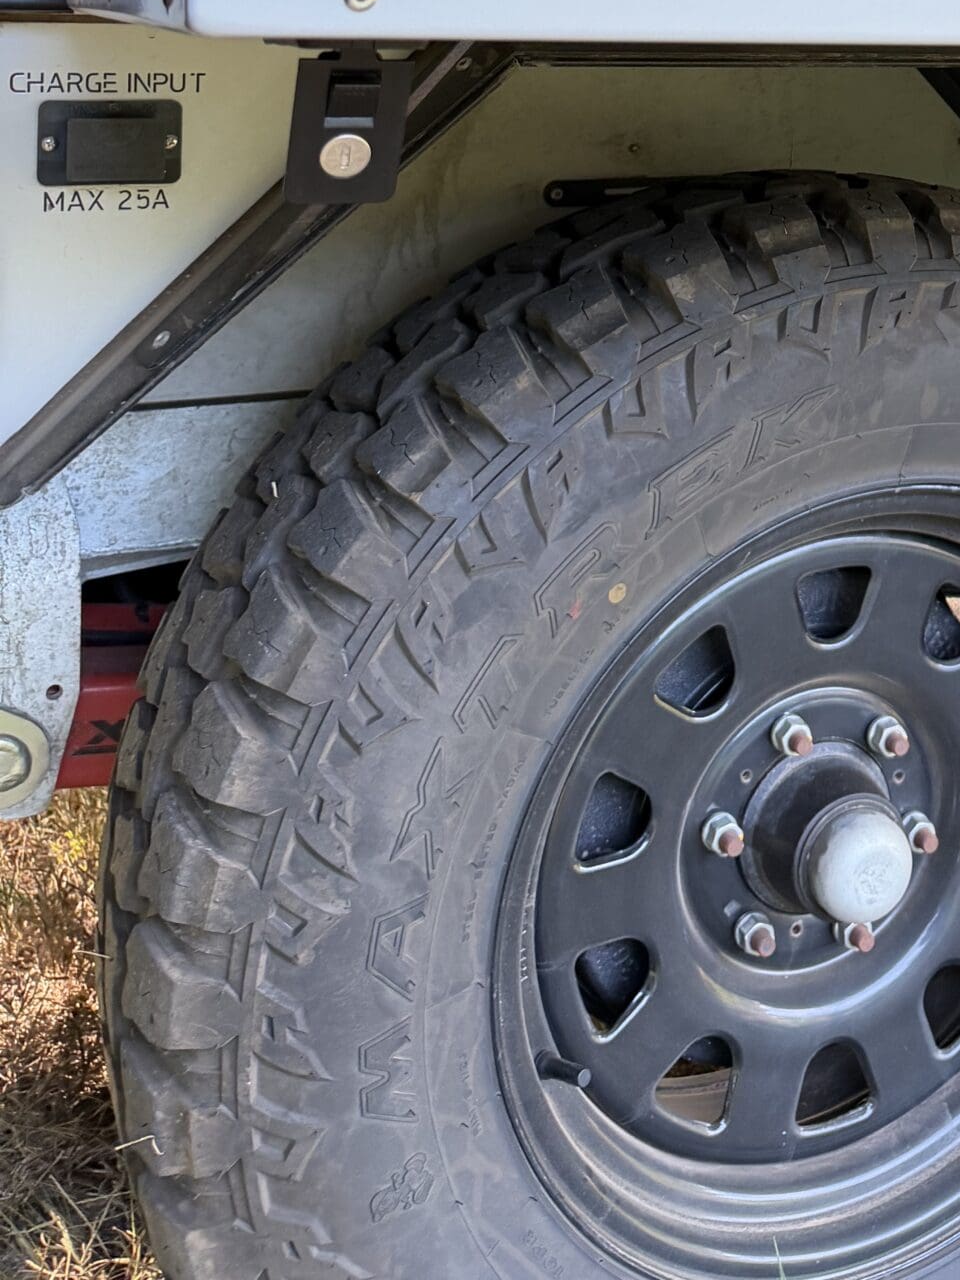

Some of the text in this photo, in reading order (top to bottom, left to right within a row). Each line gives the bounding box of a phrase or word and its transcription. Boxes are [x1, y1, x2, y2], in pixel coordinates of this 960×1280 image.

[9, 72, 207, 94] CHARGE INPUT
[43, 189, 170, 213] MAX 25A
[357, 383, 841, 1123] MAXTREK
